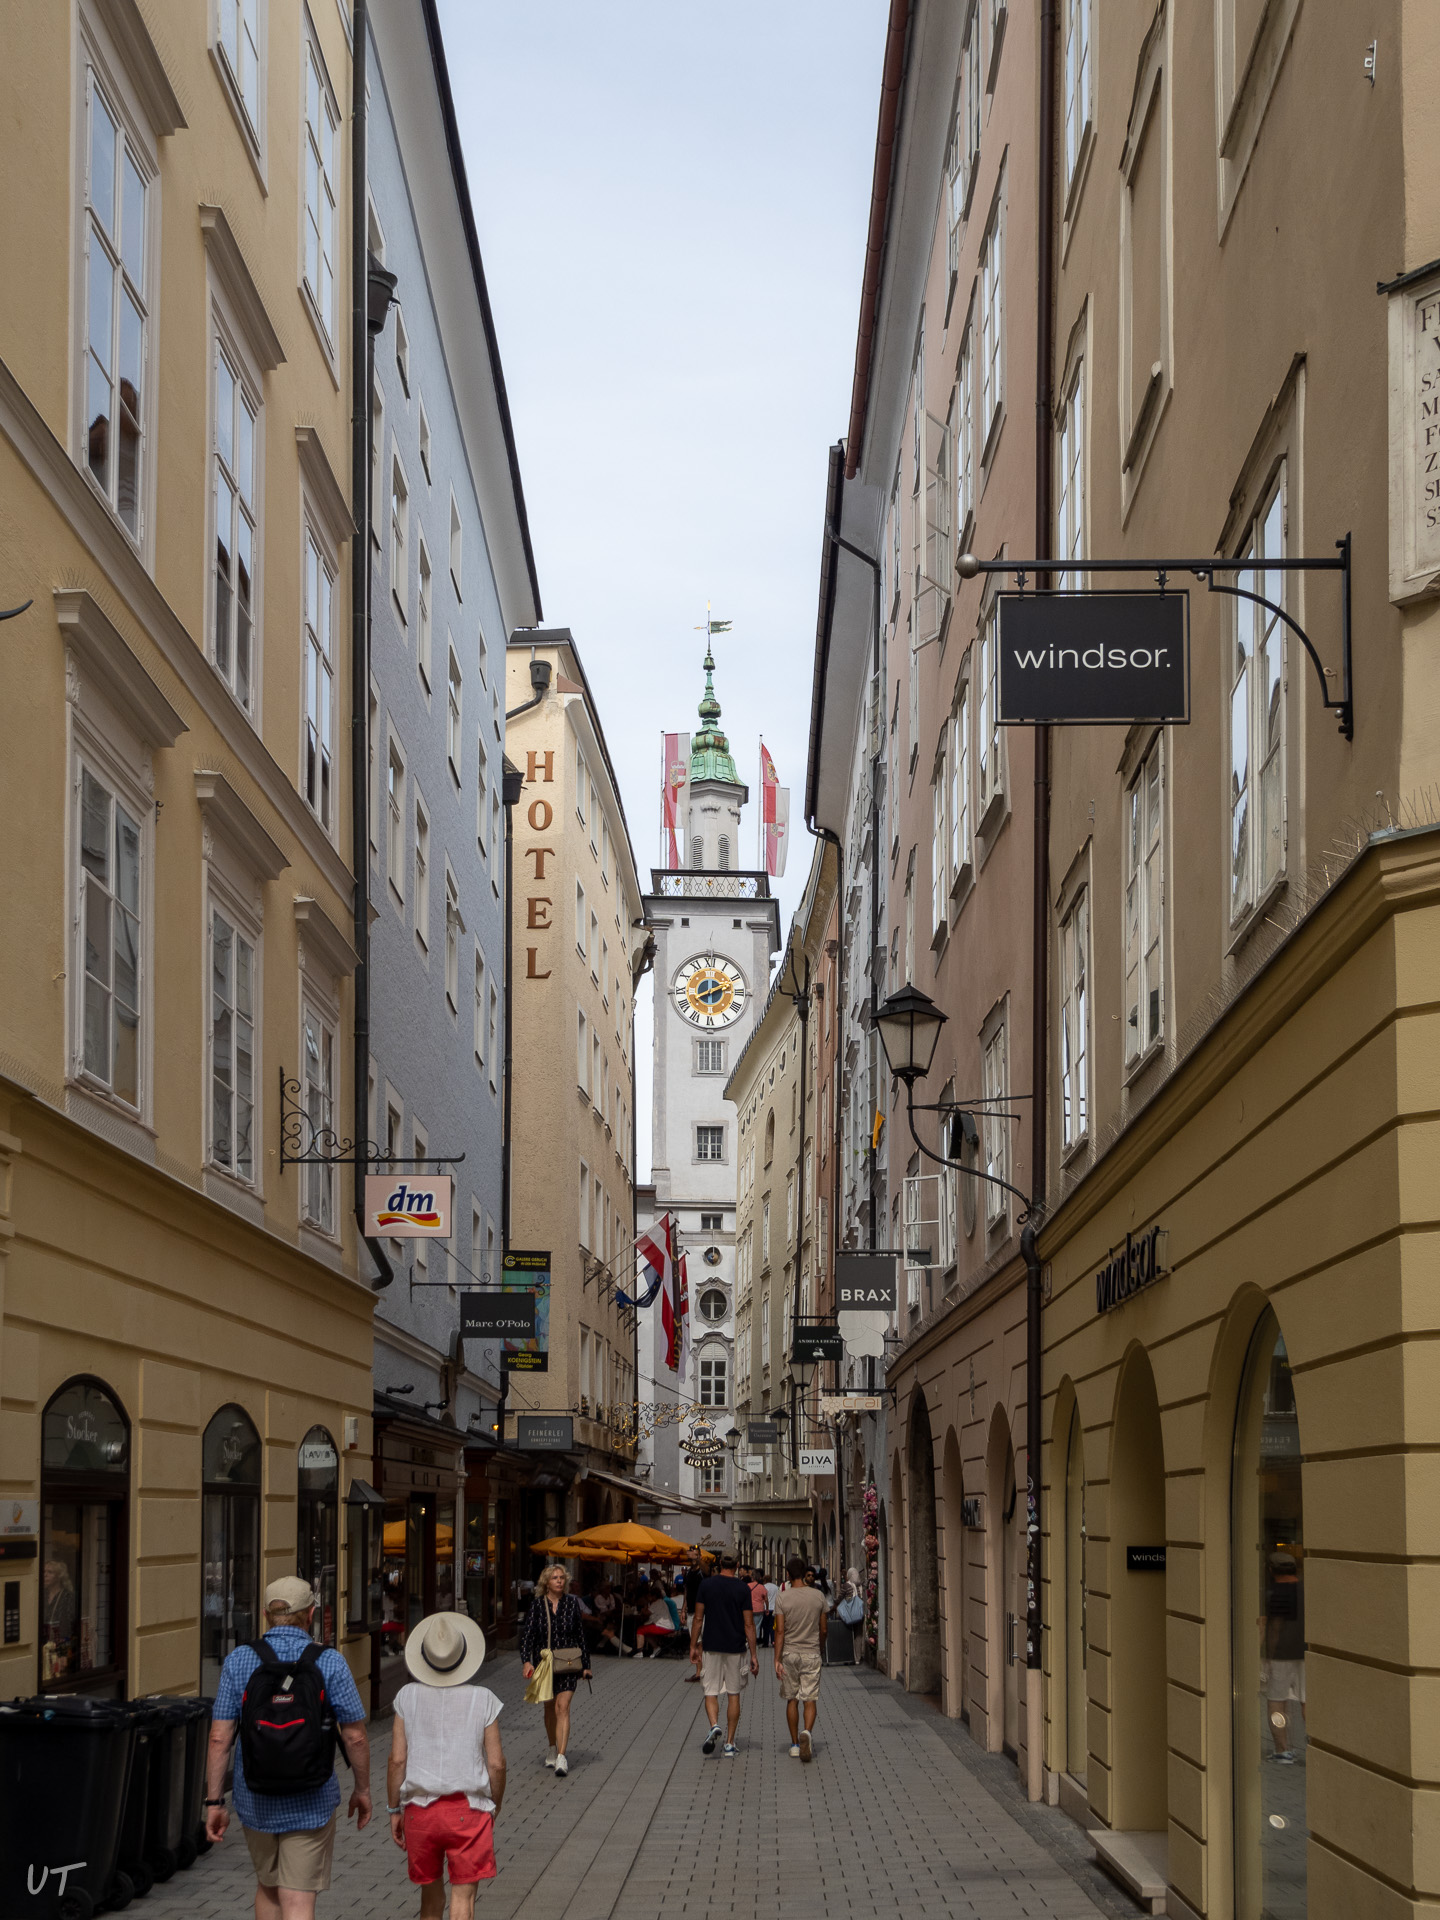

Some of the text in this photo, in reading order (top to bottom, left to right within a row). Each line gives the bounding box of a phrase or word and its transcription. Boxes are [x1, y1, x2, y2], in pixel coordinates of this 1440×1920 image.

[1421, 302, 1440, 332] F
[1425, 424, 1440, 446] F
[1013, 642, 1172, 670] windsor.
[525, 750, 555, 979] HOTEL
[690, 960, 702, 972] XI
[679, 971, 691, 981] X
[675, 986, 686, 995] IX
[734, 988, 745, 997] III
[721, 1013, 730, 1023] V
[388, 1185, 433, 1212] dm
[841, 1289, 892, 1301] BRAX
[465, 1319, 531, 1328] Marc O'Polo
[528, 1429, 564, 1437] FEINERLEI
[681, 1442, 722, 1454] RESTAURANT
[687, 1458, 718, 1467] HOTEL
[801, 1456, 832, 1464] DIVA
